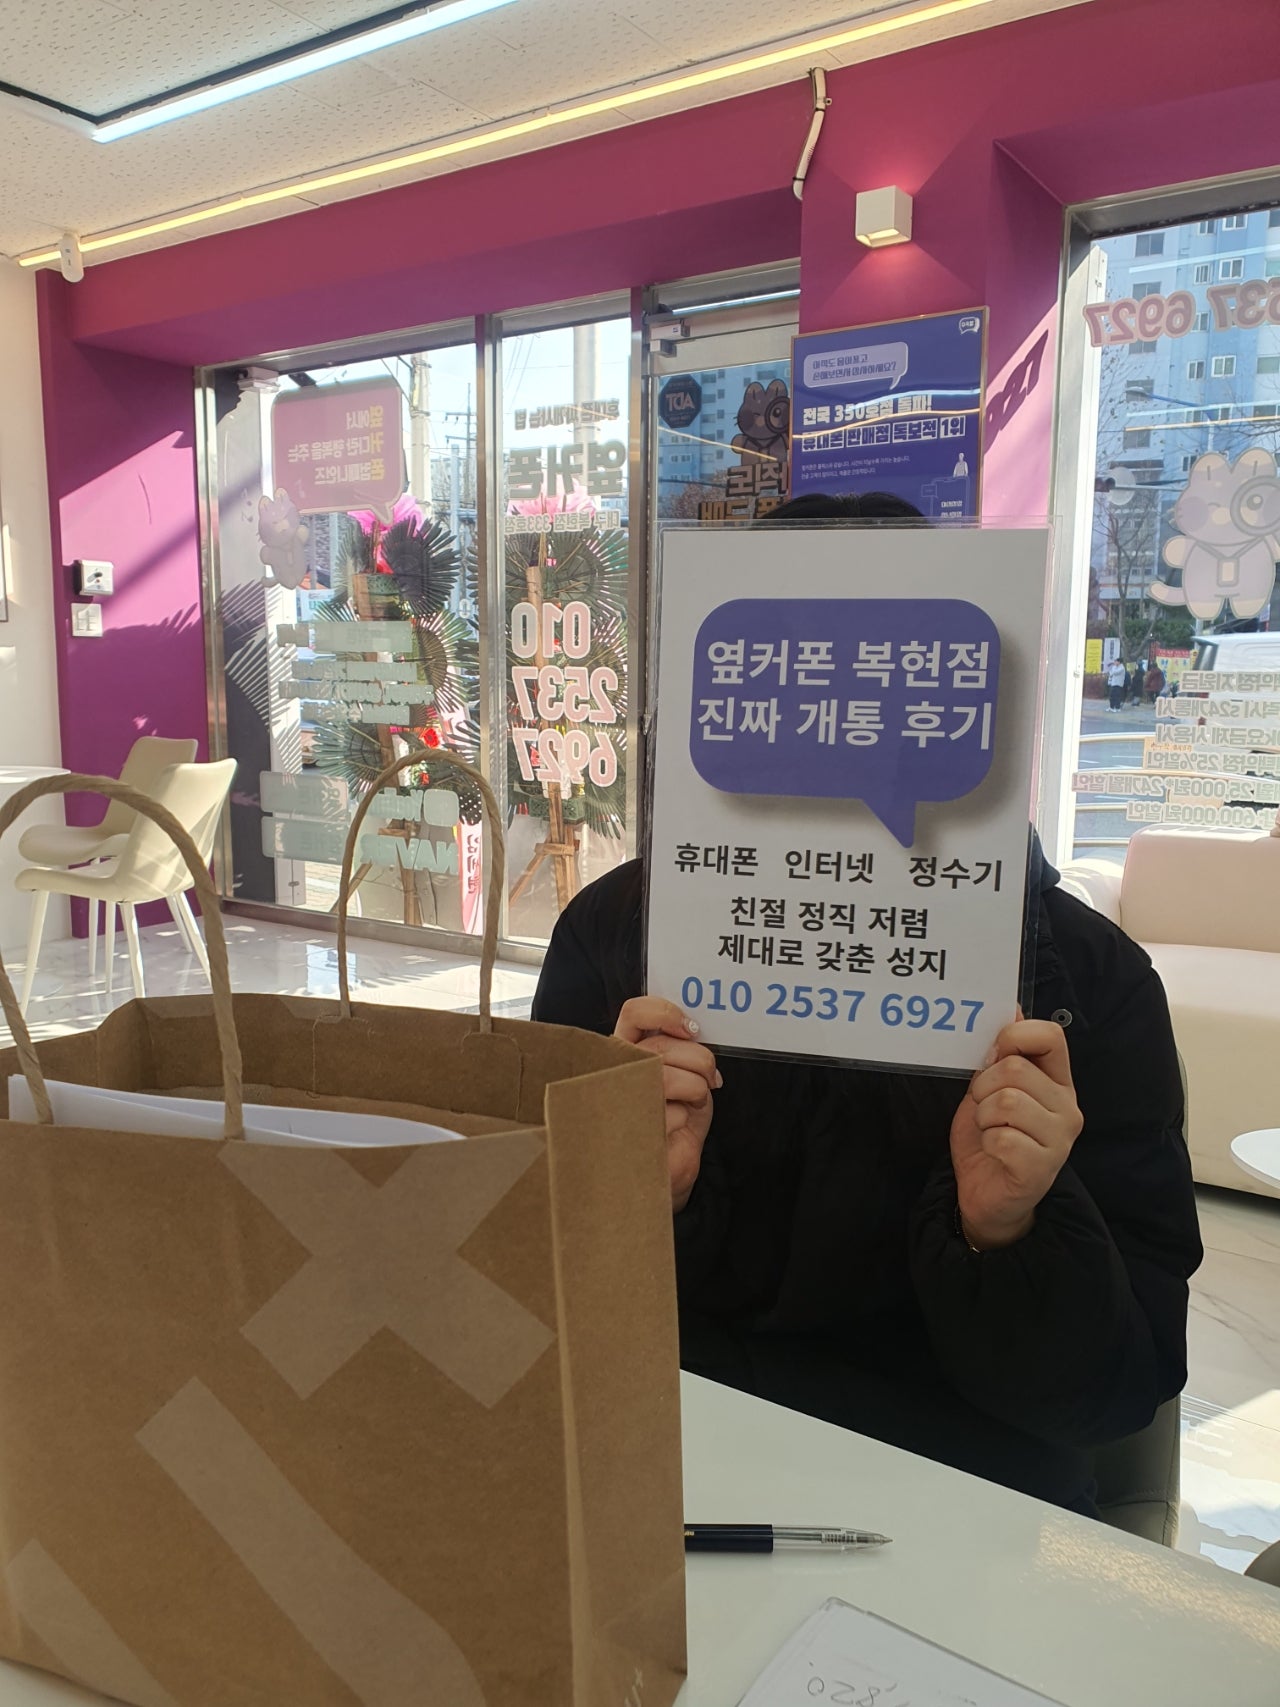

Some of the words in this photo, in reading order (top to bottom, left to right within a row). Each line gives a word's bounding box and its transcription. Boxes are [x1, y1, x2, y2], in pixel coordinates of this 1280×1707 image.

[803, 405, 831, 426] 전국
[892, 418, 938, 443] 독보적
[940, 416, 967, 438] 1위
[707, 639, 836, 686] 옆커폰
[852, 640, 990, 689] 복현점
[697, 697, 782, 744] 진짜
[796, 699, 885, 746] 개통
[901, 701, 993, 750] 후기
[674, 843, 759, 877] 휴대폰
[784, 849, 874, 884] 인터넷
[908, 856, 1003, 892] 정수기
[730, 896, 786, 929] 친절
[798, 902, 856, 935] 정직
[868, 907, 929, 940] 저렴
[717, 934, 804, 967] 제대로
[815, 941, 876, 974] 갖춘
[887, 947, 947, 981] 성지
[681, 976, 752, 1013] 010
[765, 983, 866, 1022] 2537
[880, 993, 985, 1033] 6927
